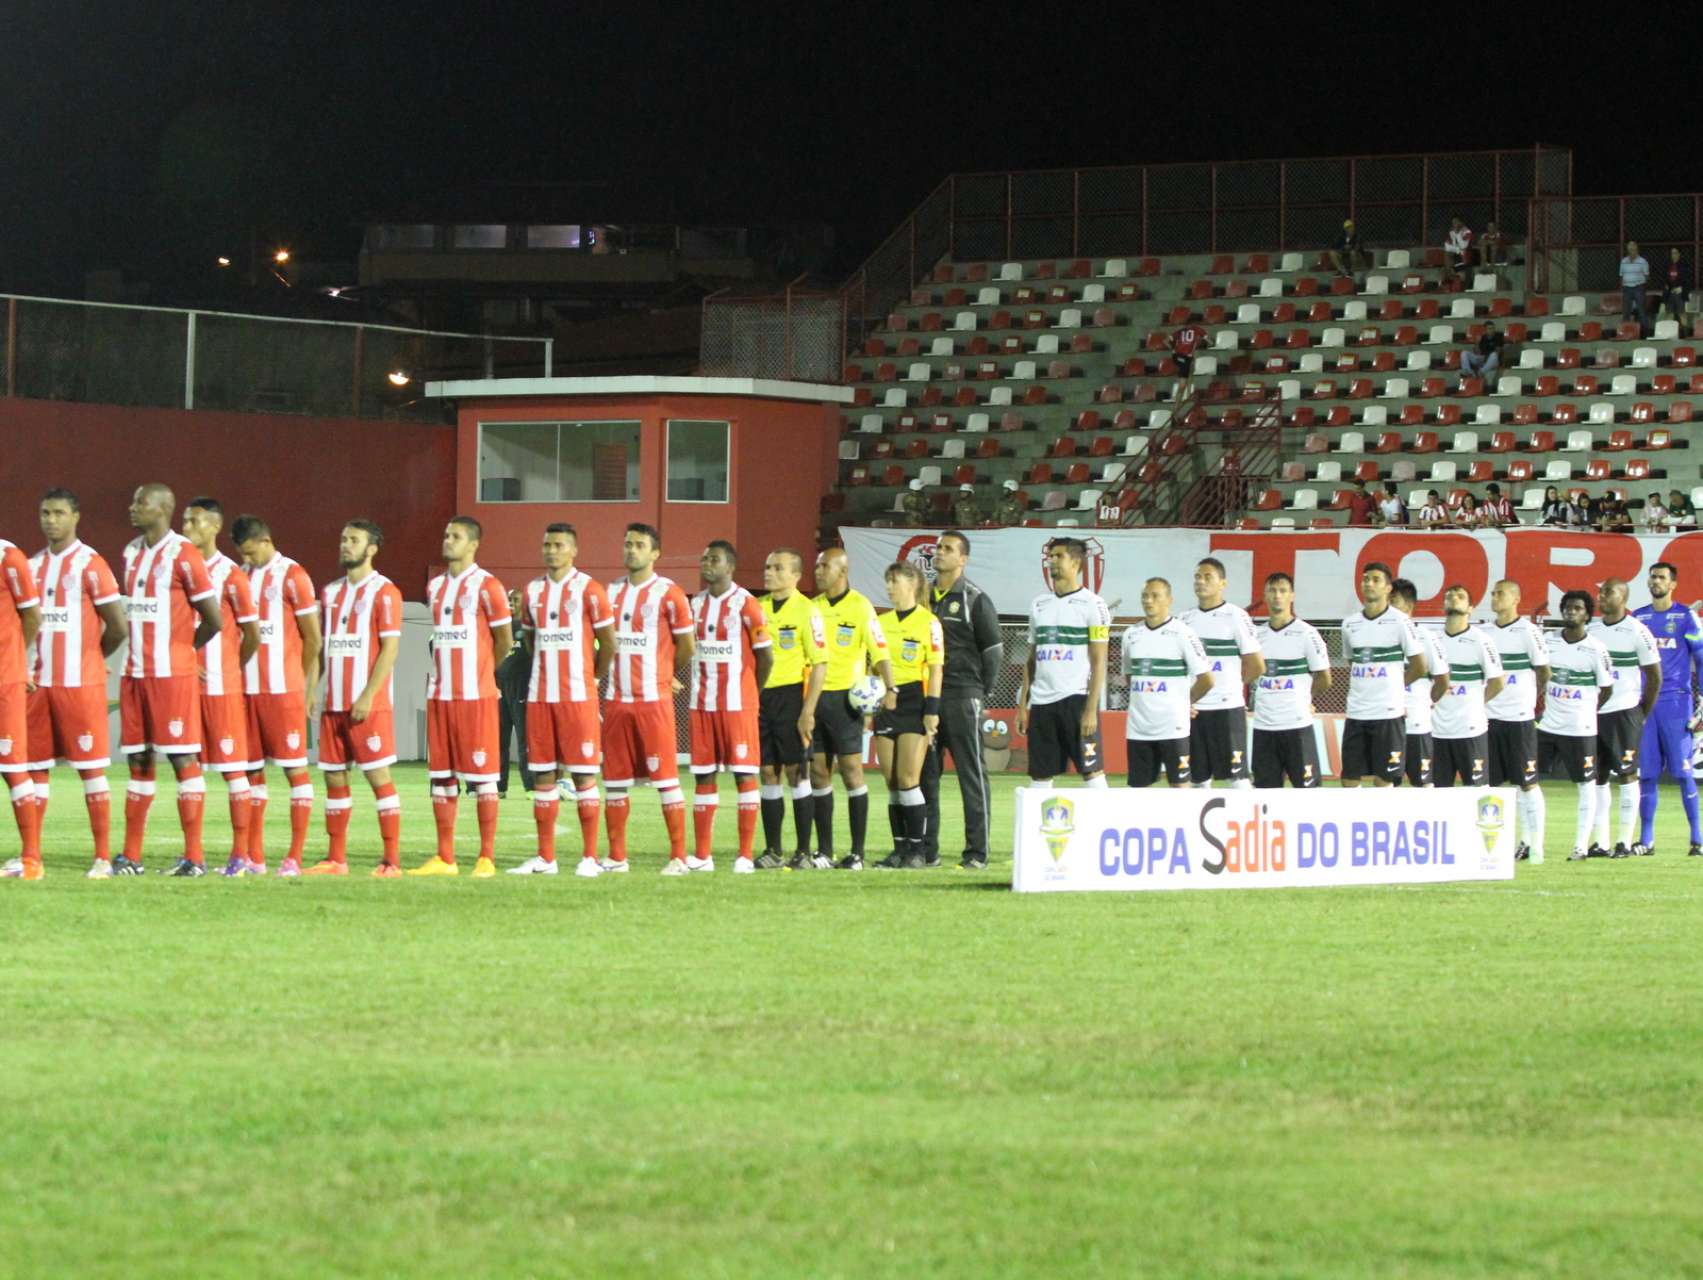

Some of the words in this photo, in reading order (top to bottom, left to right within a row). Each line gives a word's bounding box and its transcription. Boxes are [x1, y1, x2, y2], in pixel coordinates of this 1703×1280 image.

[1180, 329, 1195, 342] 10
[1099, 828, 1191, 876] COPA
[1200, 797, 1286, 875] Sadia
[1297, 822, 1339, 868] DO
[1351, 820, 1455, 867] BRASIL
